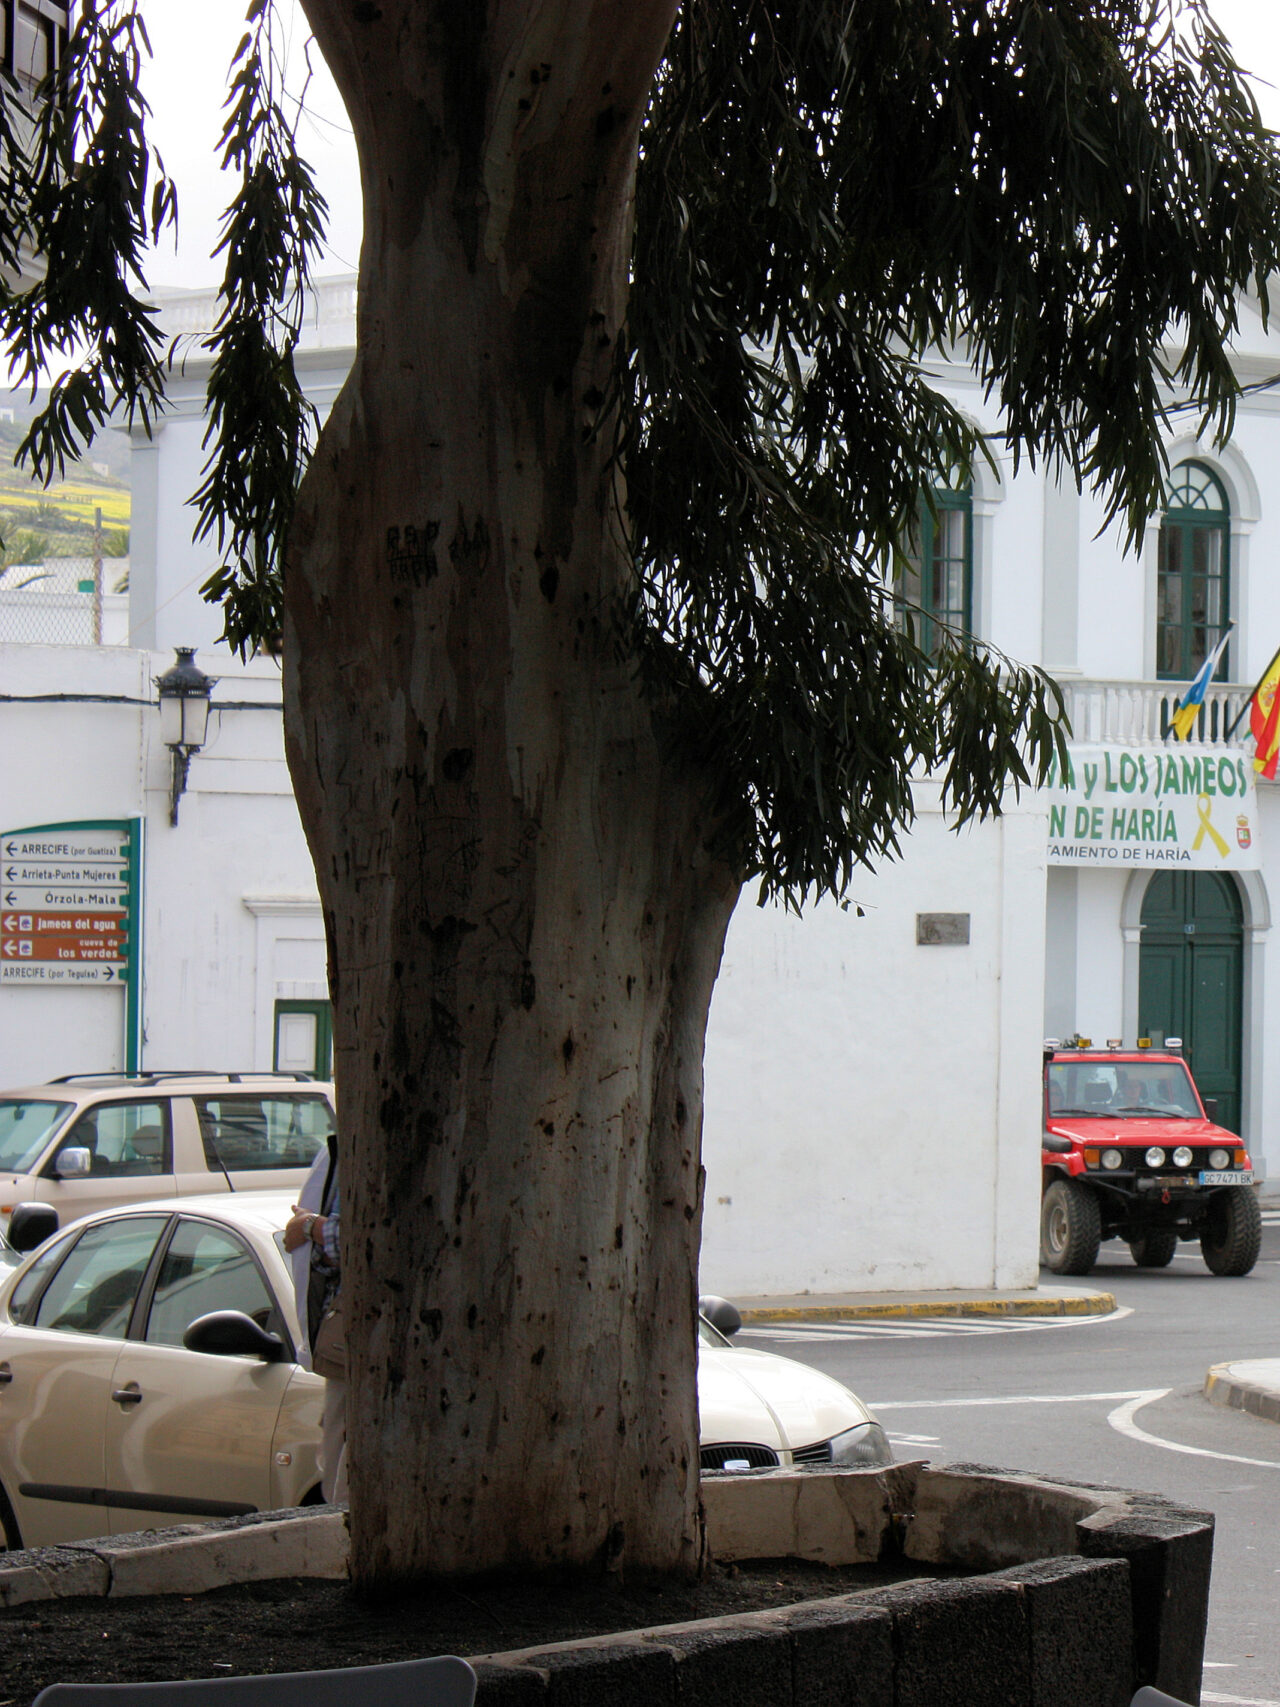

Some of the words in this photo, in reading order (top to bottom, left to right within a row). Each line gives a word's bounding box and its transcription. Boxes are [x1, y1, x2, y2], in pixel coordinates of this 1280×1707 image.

[1084, 763, 1098, 800] y
[1104, 751, 1149, 794] LOS
[1154, 754, 1247, 799] JAMEOS
[1047, 805, 1067, 838] N
[1074, 806, 1104, 840] DE
[1111, 801, 1178, 843] HARÍA
[22, 844, 69, 855] ARRECIFE
[71, 847, 86, 856] (por
[1122, 848, 1141, 860] DE
[1145, 848, 1191, 861] HARÍA
[22, 869, 80, 880] Arrieta-Punta
[83, 870, 116, 881] Mujeres
[75, 919, 91, 930] del
[93, 920, 116, 932] agua
[58, 948, 76, 958] los
[80, 949, 118, 959] verdes
[4, 967, 45, 978] ARRECIFE
[48, 969, 64, 980] (por
